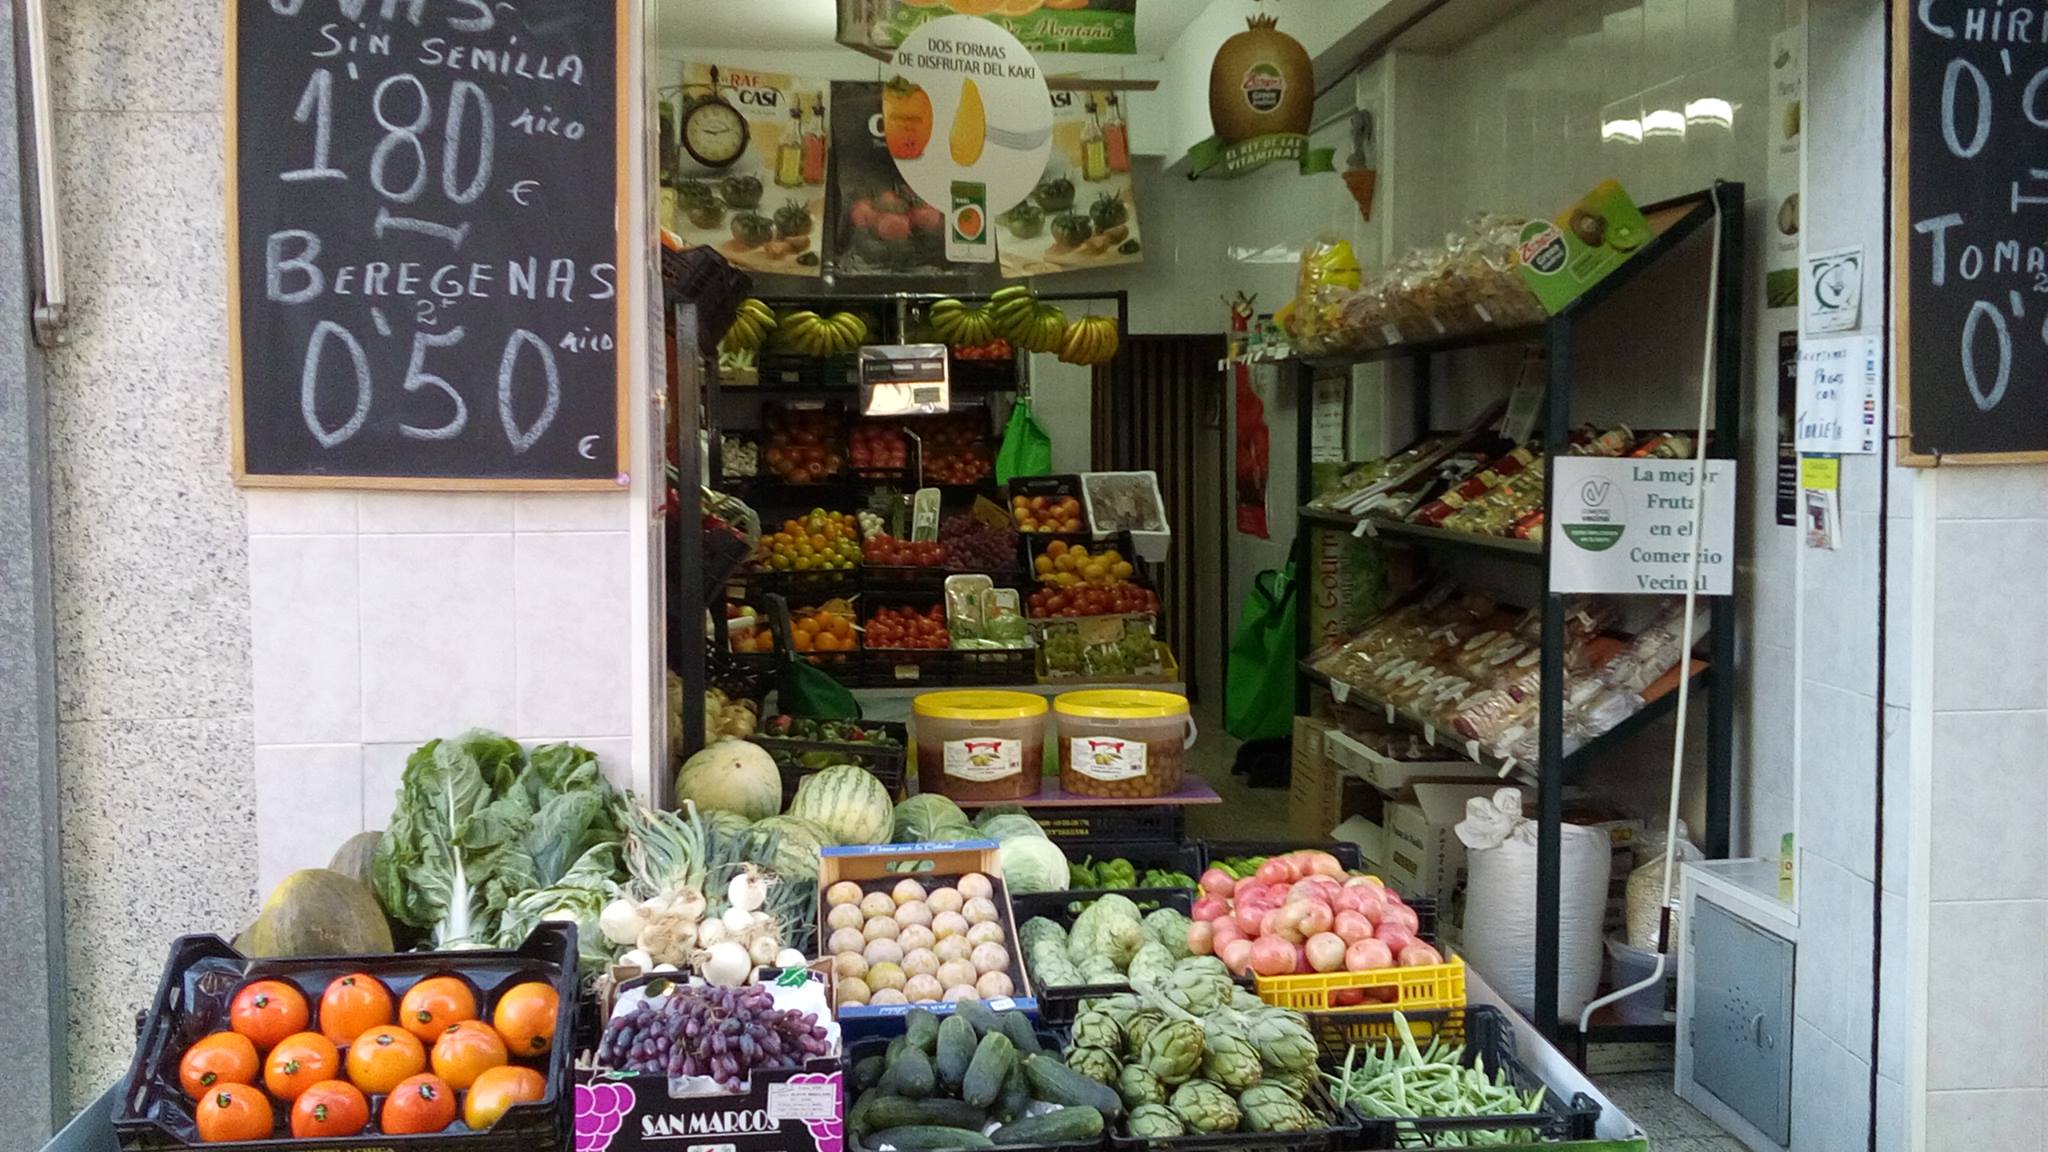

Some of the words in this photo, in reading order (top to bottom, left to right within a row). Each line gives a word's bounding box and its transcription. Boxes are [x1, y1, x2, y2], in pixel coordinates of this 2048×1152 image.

[1918, 0, 2048, 43] CHIR
[928, 38, 952, 52] DOS
[955, 41, 1006, 60] FORMAS
[898, 53, 914, 66] DE
[917, 55, 981, 76] DISFRUTAR
[983, 61, 1005, 77] DEL
[1008, 64, 1036, 80] KAKI
[731, 73, 761, 88] RAF
[739, 90, 777, 107] CASI
[265, 229, 616, 303] BEREGENAS
[1632, 466, 1653, 482] La
[1649, 524, 1672, 536] en
[1677, 520, 1693, 537] el
[641, 1113, 685, 1136] SAN
[689, 1109, 780, 1134] MARCOS
